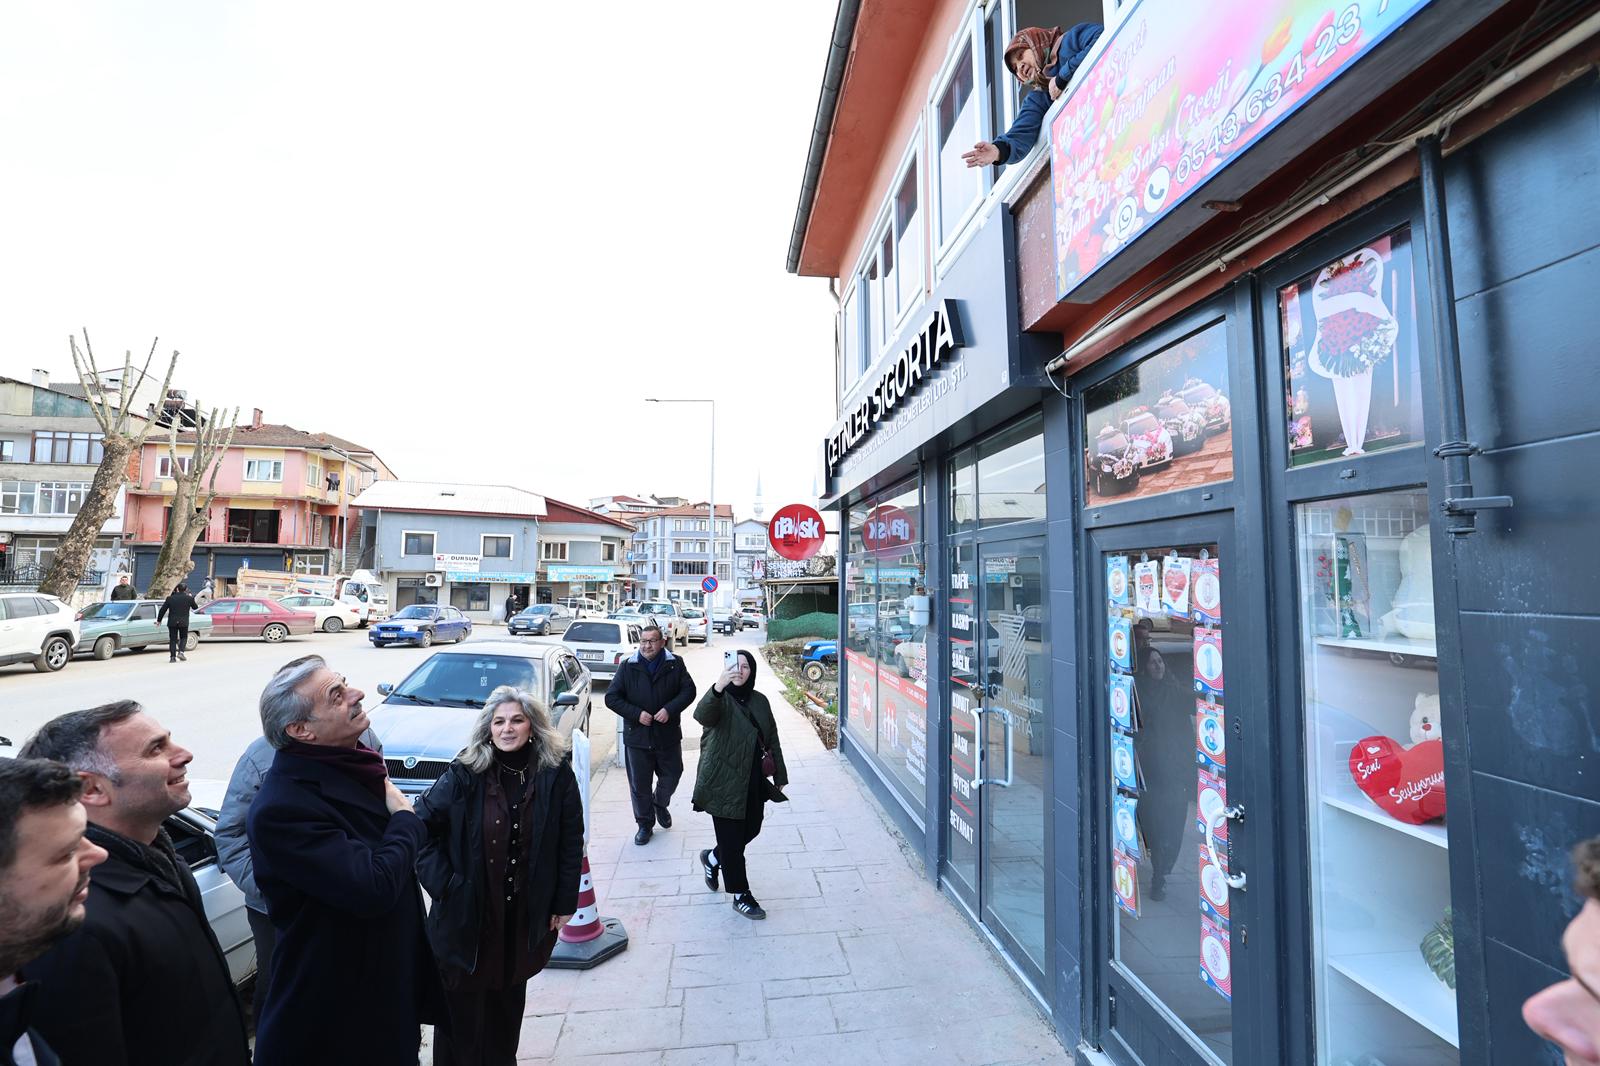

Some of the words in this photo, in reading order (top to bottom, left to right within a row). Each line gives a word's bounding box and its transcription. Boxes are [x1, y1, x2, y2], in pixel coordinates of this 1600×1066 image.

[1106, 18, 1147, 90] Sepet
[1110, 55, 1176, 141] Aranjman
[1175, 112, 1240, 185] 0543
[1244, 50, 1307, 125] 634
[1314, 2, 1362, 68] 23
[1126, 128, 1170, 185] Saksı
[1174, 56, 1232, 141] Çiçeği
[872, 299, 955, 423] SİGORTA
[951, 613, 970, 631] KASKO
[1203, 648, 1214, 678] 1
[951, 692, 970, 714] KONUT
[953, 732, 969, 756] DASK
[1204, 718, 1218, 752] 3
[1357, 758, 1381, 779] Seni
[949, 809, 974, 845] SEYAHAT
